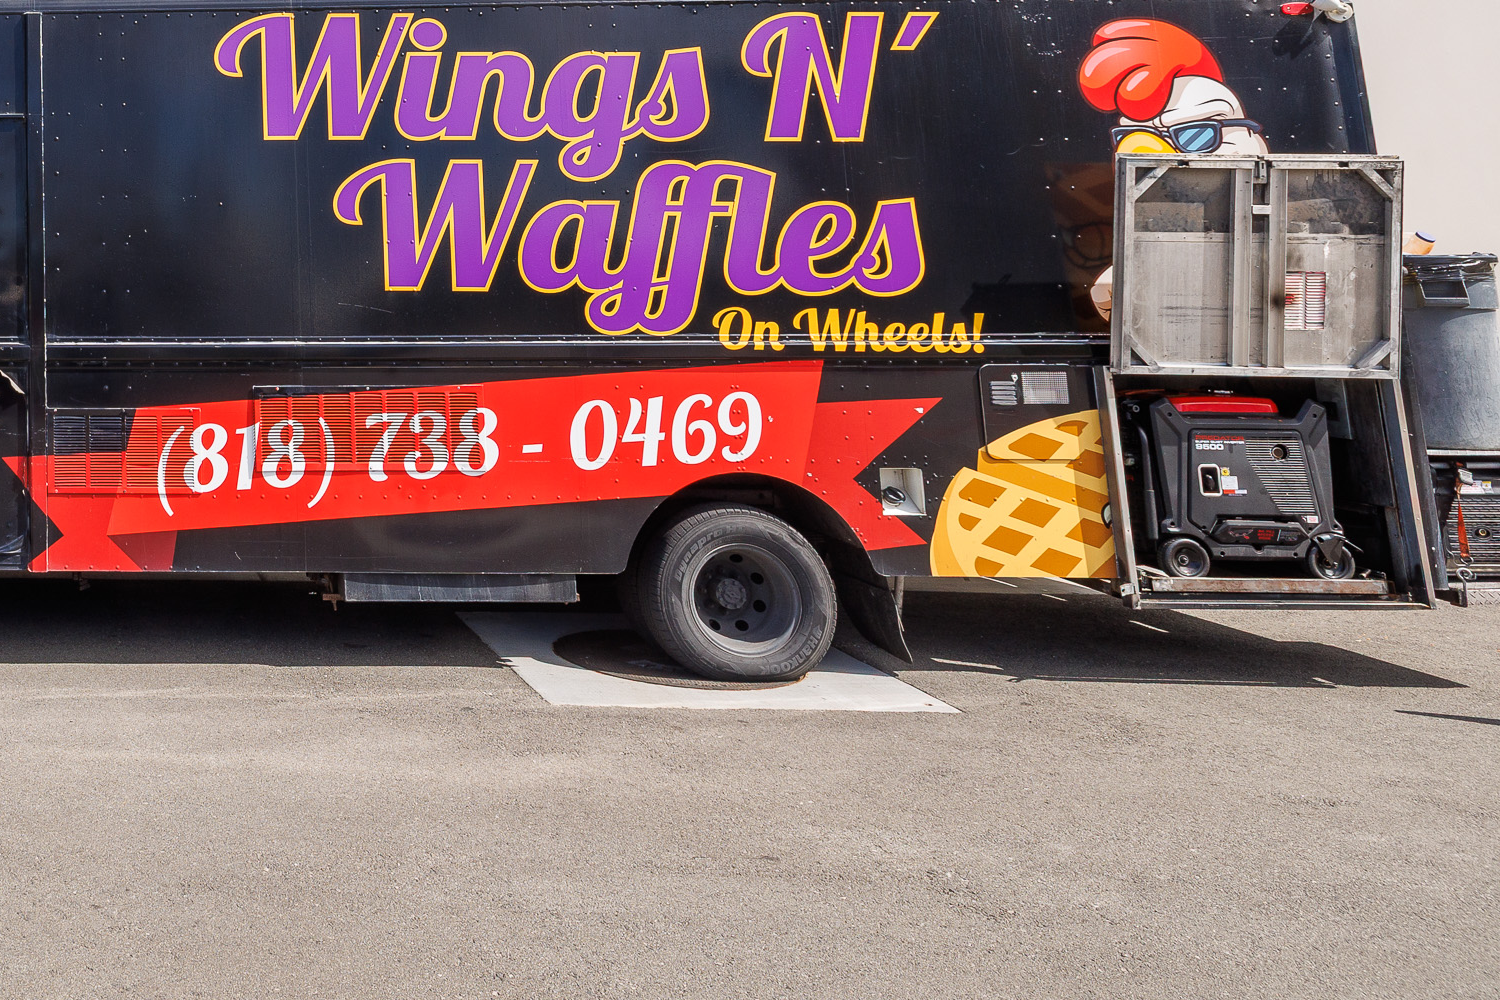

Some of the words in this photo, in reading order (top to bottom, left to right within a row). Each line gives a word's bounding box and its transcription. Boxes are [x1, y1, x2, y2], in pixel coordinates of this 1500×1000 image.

[214, 11, 711, 182] Wings
[333, 158, 926, 337] Waffles
[712, 309, 785, 353] On
[792, 307, 986, 354] Wheels!
[156, 417, 336, 518] (818)
[365, 406, 499, 483] 738
[569, 391, 764, 474] 0469
